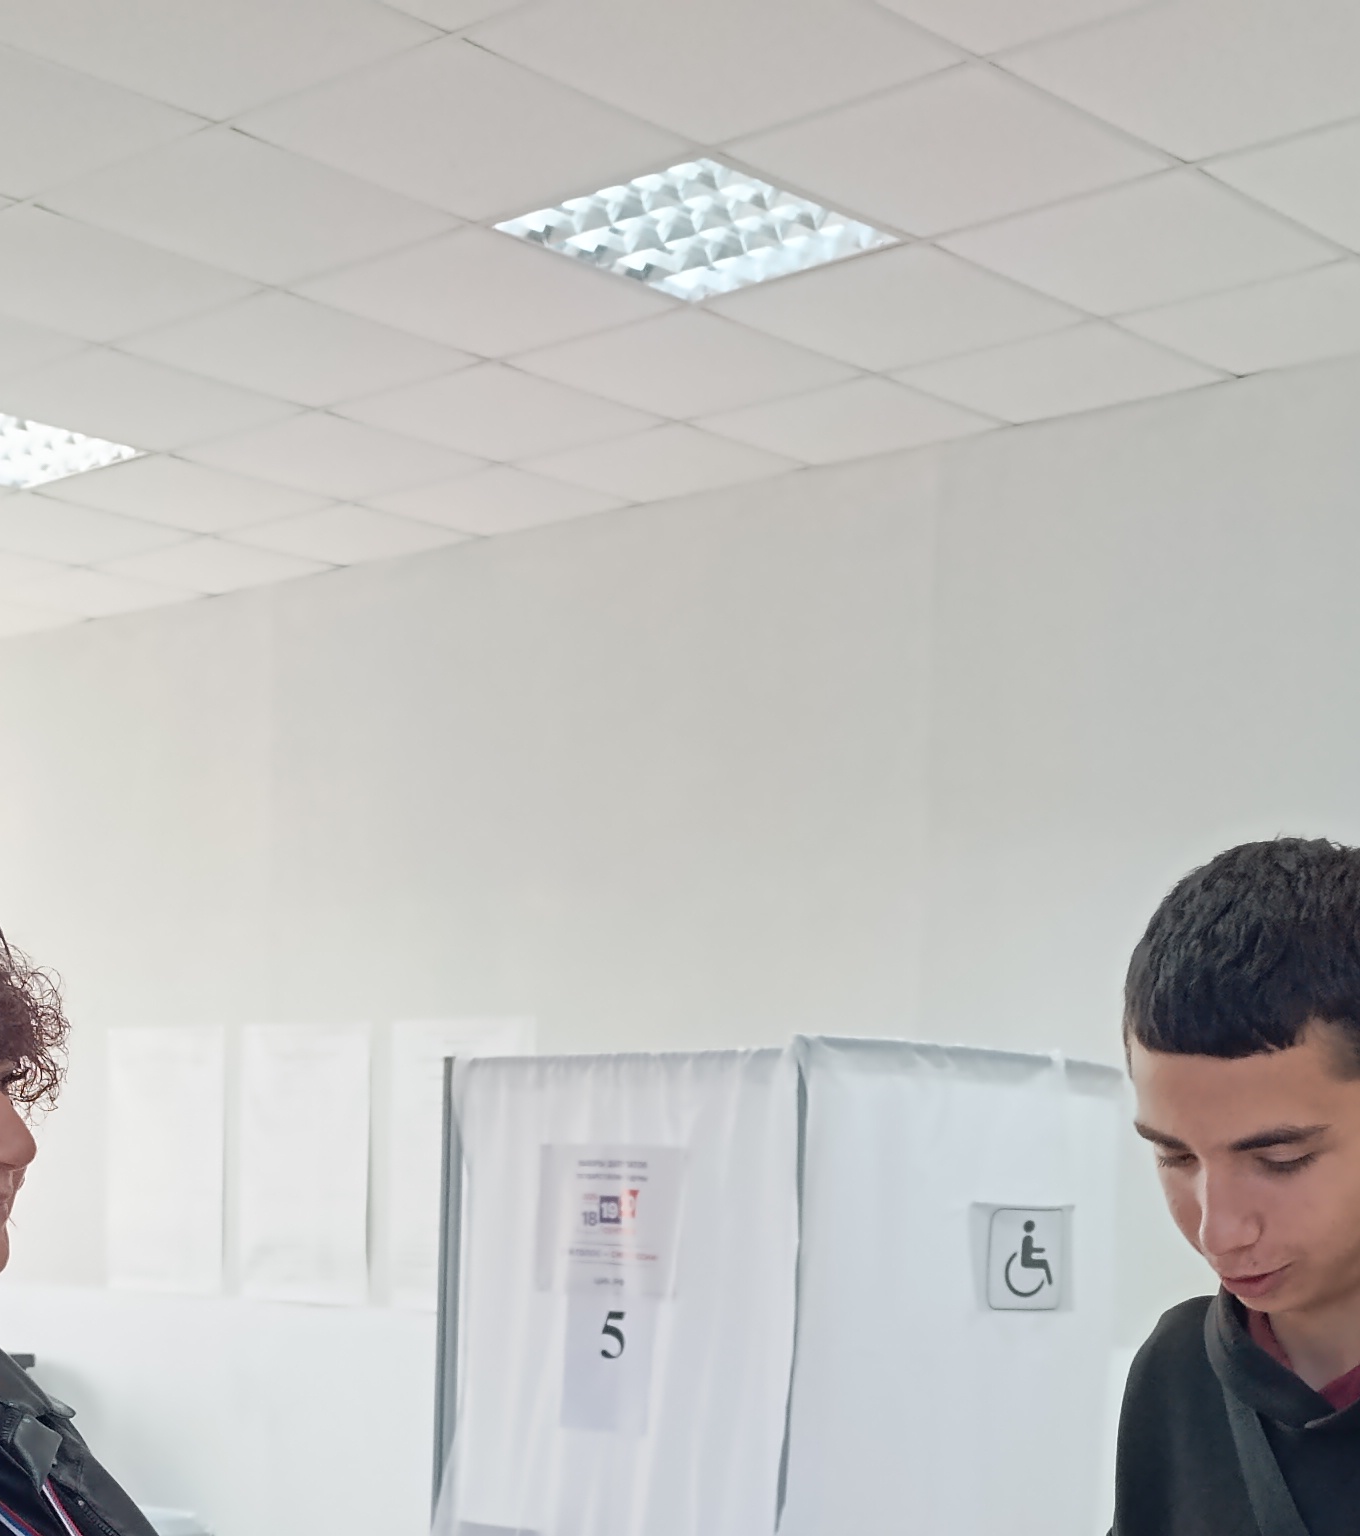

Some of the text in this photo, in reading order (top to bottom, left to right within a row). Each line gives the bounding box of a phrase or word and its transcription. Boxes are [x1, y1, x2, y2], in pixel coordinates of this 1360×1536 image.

[582, 1211, 598, 1226] 18
[601, 1202, 619, 1219] 19
[599, 1310, 627, 1360] 5
